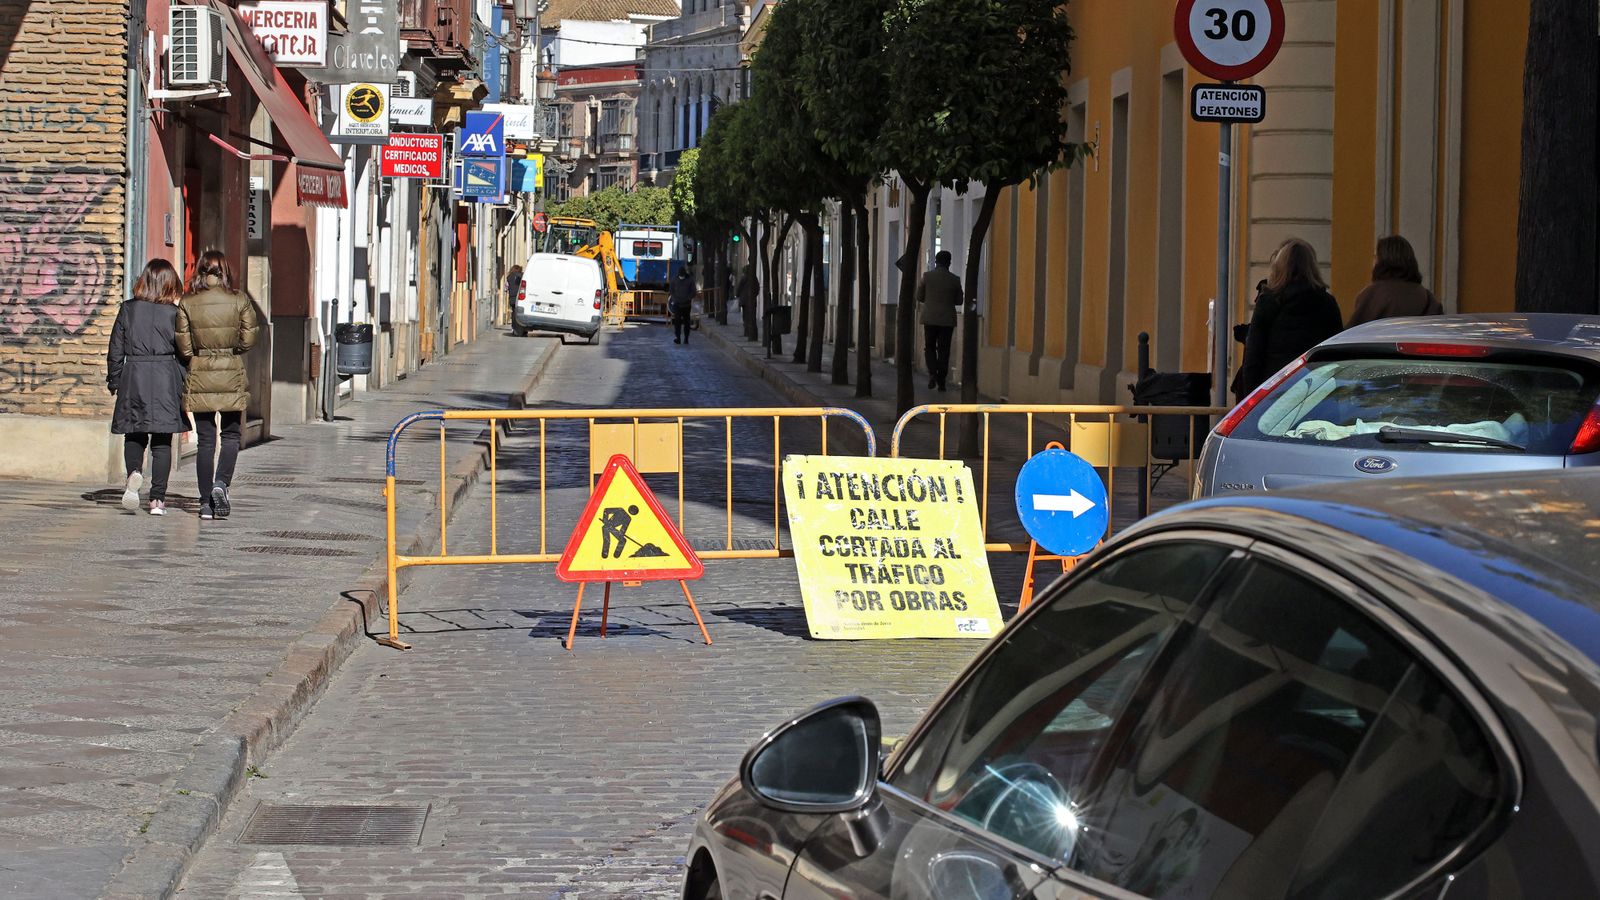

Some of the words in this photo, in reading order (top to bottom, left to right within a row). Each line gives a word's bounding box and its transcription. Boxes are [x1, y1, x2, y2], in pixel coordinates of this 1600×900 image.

[242, 10, 318, 29] MERCERIA
[1204, 8, 1256, 42] 30
[334, 44, 395, 70] Claveles
[1200, 90, 1258, 102] ATENCIÓN
[390, 104, 426, 116] imuchi
[1199, 106, 1258, 117] PEATONES
[389, 137, 439, 149] ONDUCTORES
[461, 133, 497, 152] AXA
[384, 150, 438, 162] CERTIFICADOS
[1363, 456, 1385, 469] Ford
[816, 468, 948, 503] ATENCIÓN
[850, 508, 921, 531] CALLE
[819, 535, 927, 559] CORTADA
[934, 537, 962, 560] AL
[845, 557, 945, 586] TRÁFICO
[834, 589, 884, 612] POR
[889, 590, 969, 612] OBRAS
